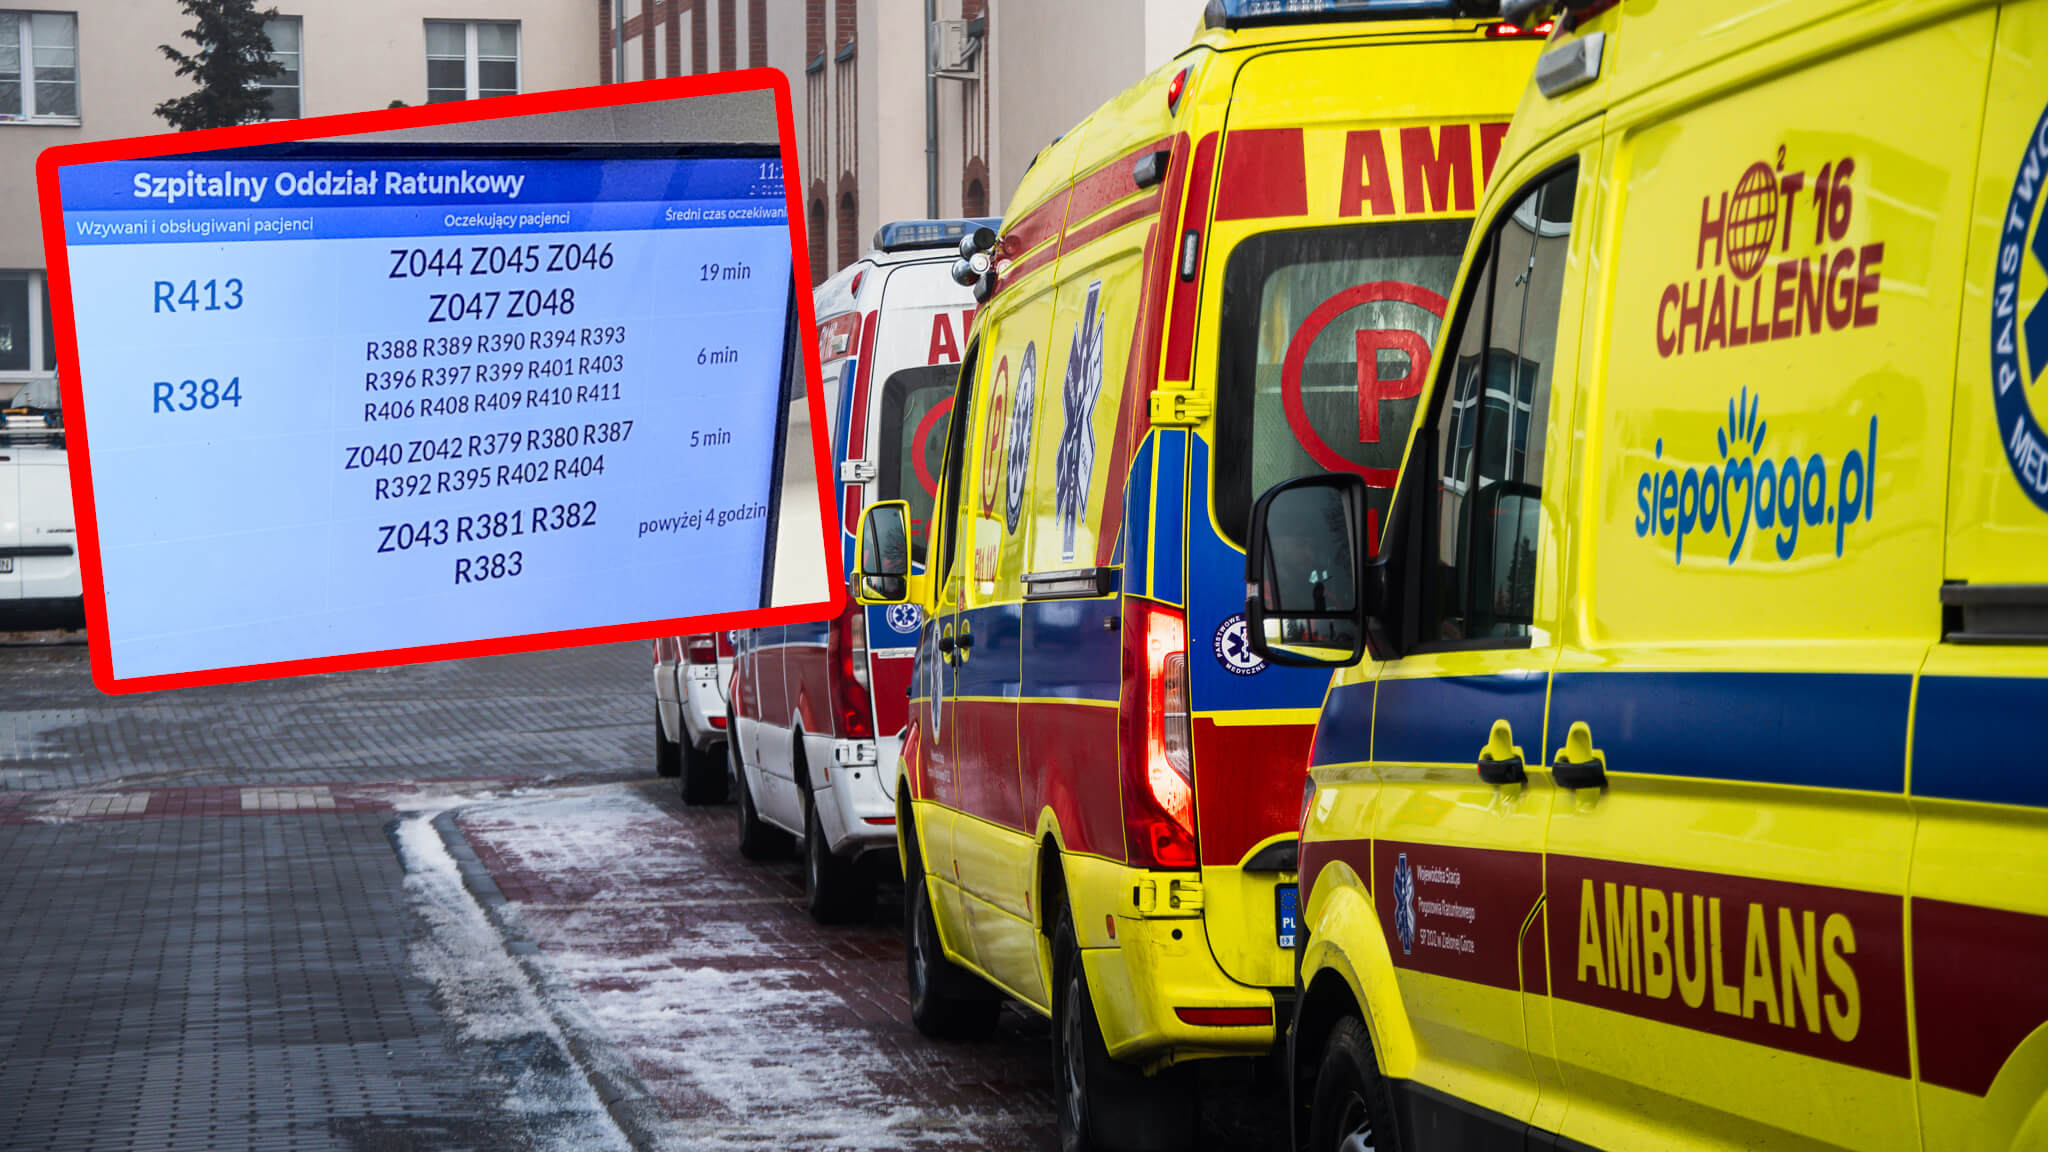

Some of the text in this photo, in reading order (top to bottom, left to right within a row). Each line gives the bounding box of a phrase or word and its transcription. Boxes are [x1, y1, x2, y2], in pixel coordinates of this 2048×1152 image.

[133, 168, 525, 203] Szpitalny Oddział Ratunkowy
[1812, 157, 1856, 246] 16
[77, 216, 314, 237] Wzywani i obsługiwani pacjenci
[444, 210, 571, 229] Oczekujący pacjenci
[665, 205, 701, 222] Średni
[703, 209, 727, 221] czas
[389, 242, 614, 279] Z044 Z045 Z046
[700, 262, 751, 282] 19 min
[153, 278, 244, 313] R413
[428, 288, 575, 323] Z047 Z048
[1656, 241, 1885, 358] CHALLENGE
[367, 326, 626, 361] R388 R389 R390 R394 R393
[928, 310, 976, 365] A
[365, 355, 624, 392] R396 R397 R399 R401 R403
[697, 347, 739, 366] 6 min
[153, 376, 242, 414] R384
[364, 383, 622, 423] R406 R408 R409 R410 R411
[345, 420, 634, 470] Z040 Z042 R379 R380 R387
[690, 429, 731, 448] 5 min
[375, 455, 605, 500] R392 R395 R402 R404
[1635, 413, 1878, 566] siepomaga.pl
[377, 500, 598, 554] Z043 R381 R382
[638, 502, 767, 538] powyżej 4 godzin
[454, 551, 523, 585] R383
[1225, 662, 1266, 675] MEDYCZNE
[1282, 916, 1296, 929] PL
[1577, 878, 1861, 1043] AMBULANS
